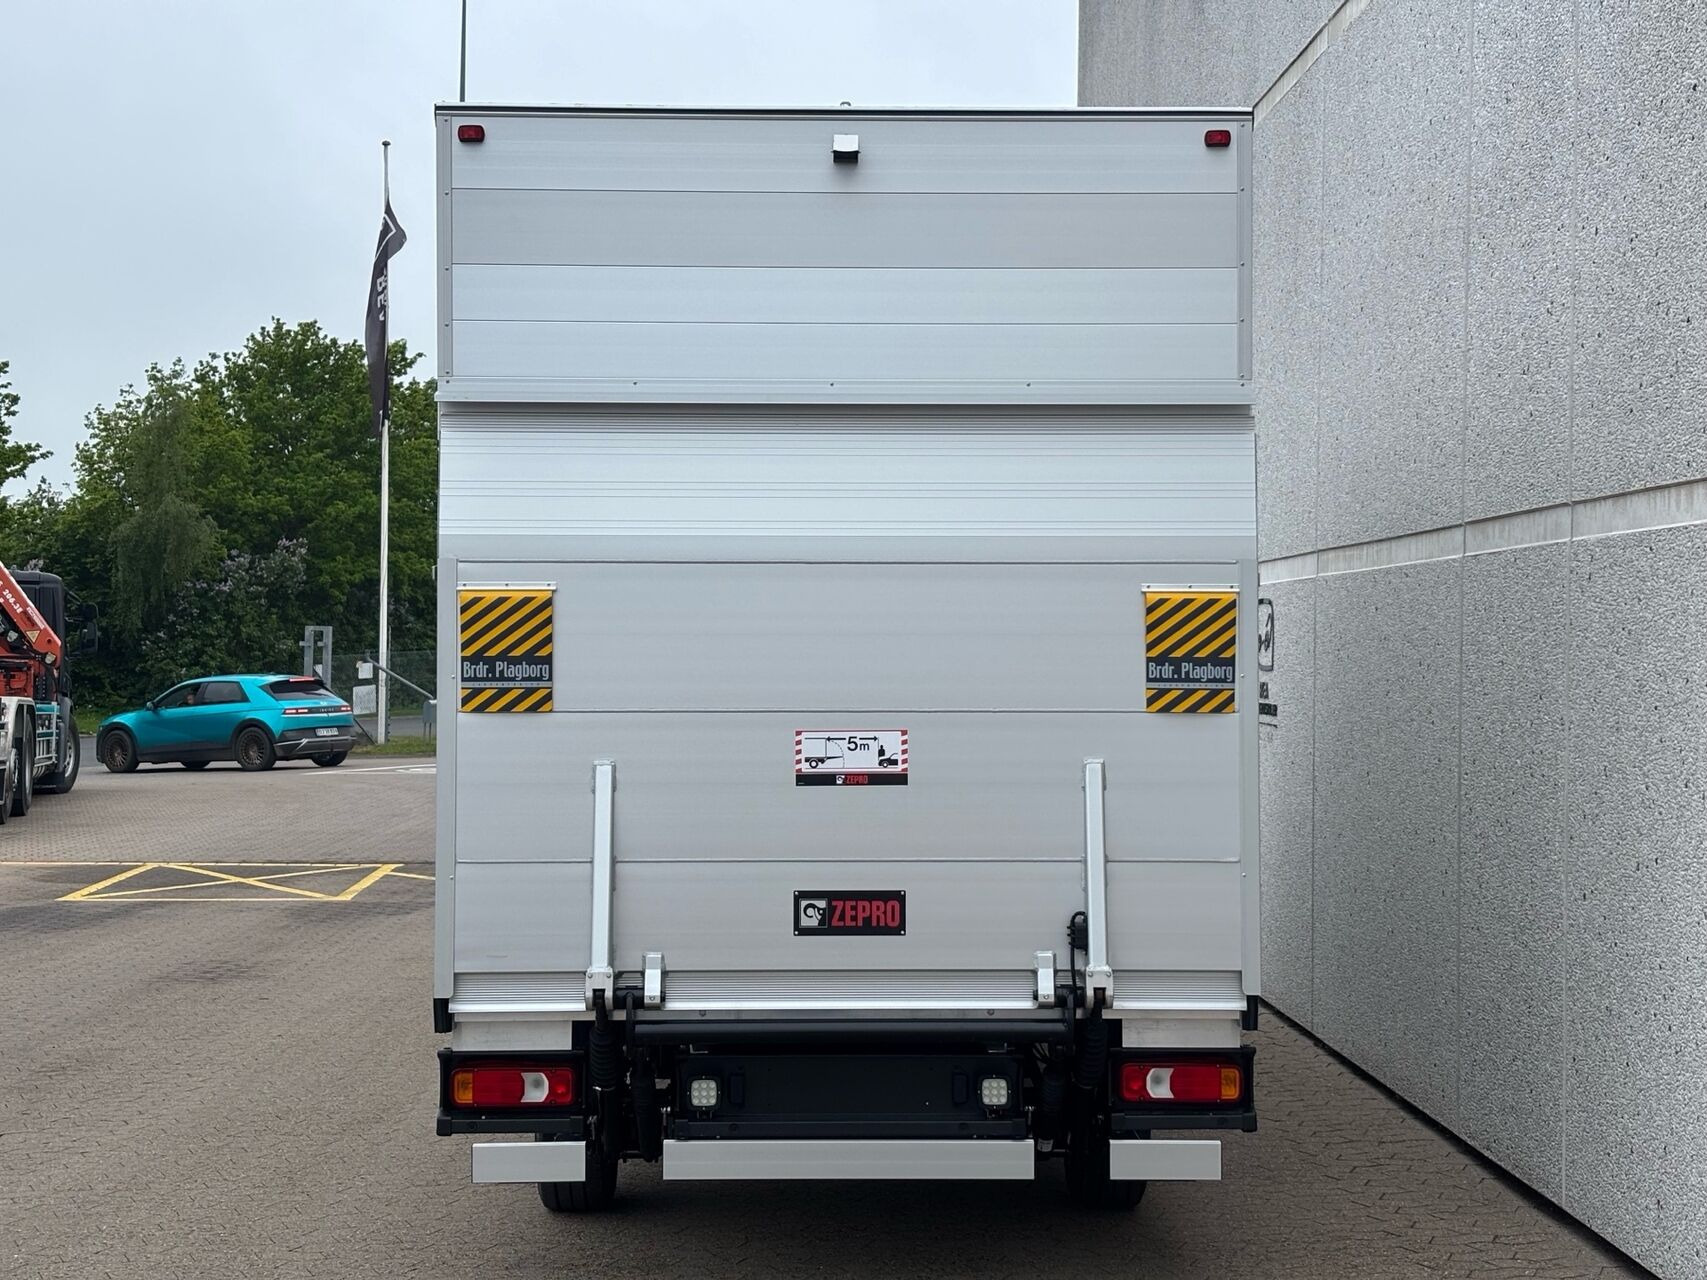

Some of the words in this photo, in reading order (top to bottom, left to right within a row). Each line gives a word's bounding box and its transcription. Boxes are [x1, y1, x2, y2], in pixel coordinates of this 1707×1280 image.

[463, 661, 492, 678] Brdr.
[495, 661, 549, 681] Plagborg
[1148, 662, 1178, 679] Brdr.
[1181, 662, 1233, 682] Plagborg
[846, 775, 869, 785] ZEPRO
[831, 900, 900, 927] ZEPRO
